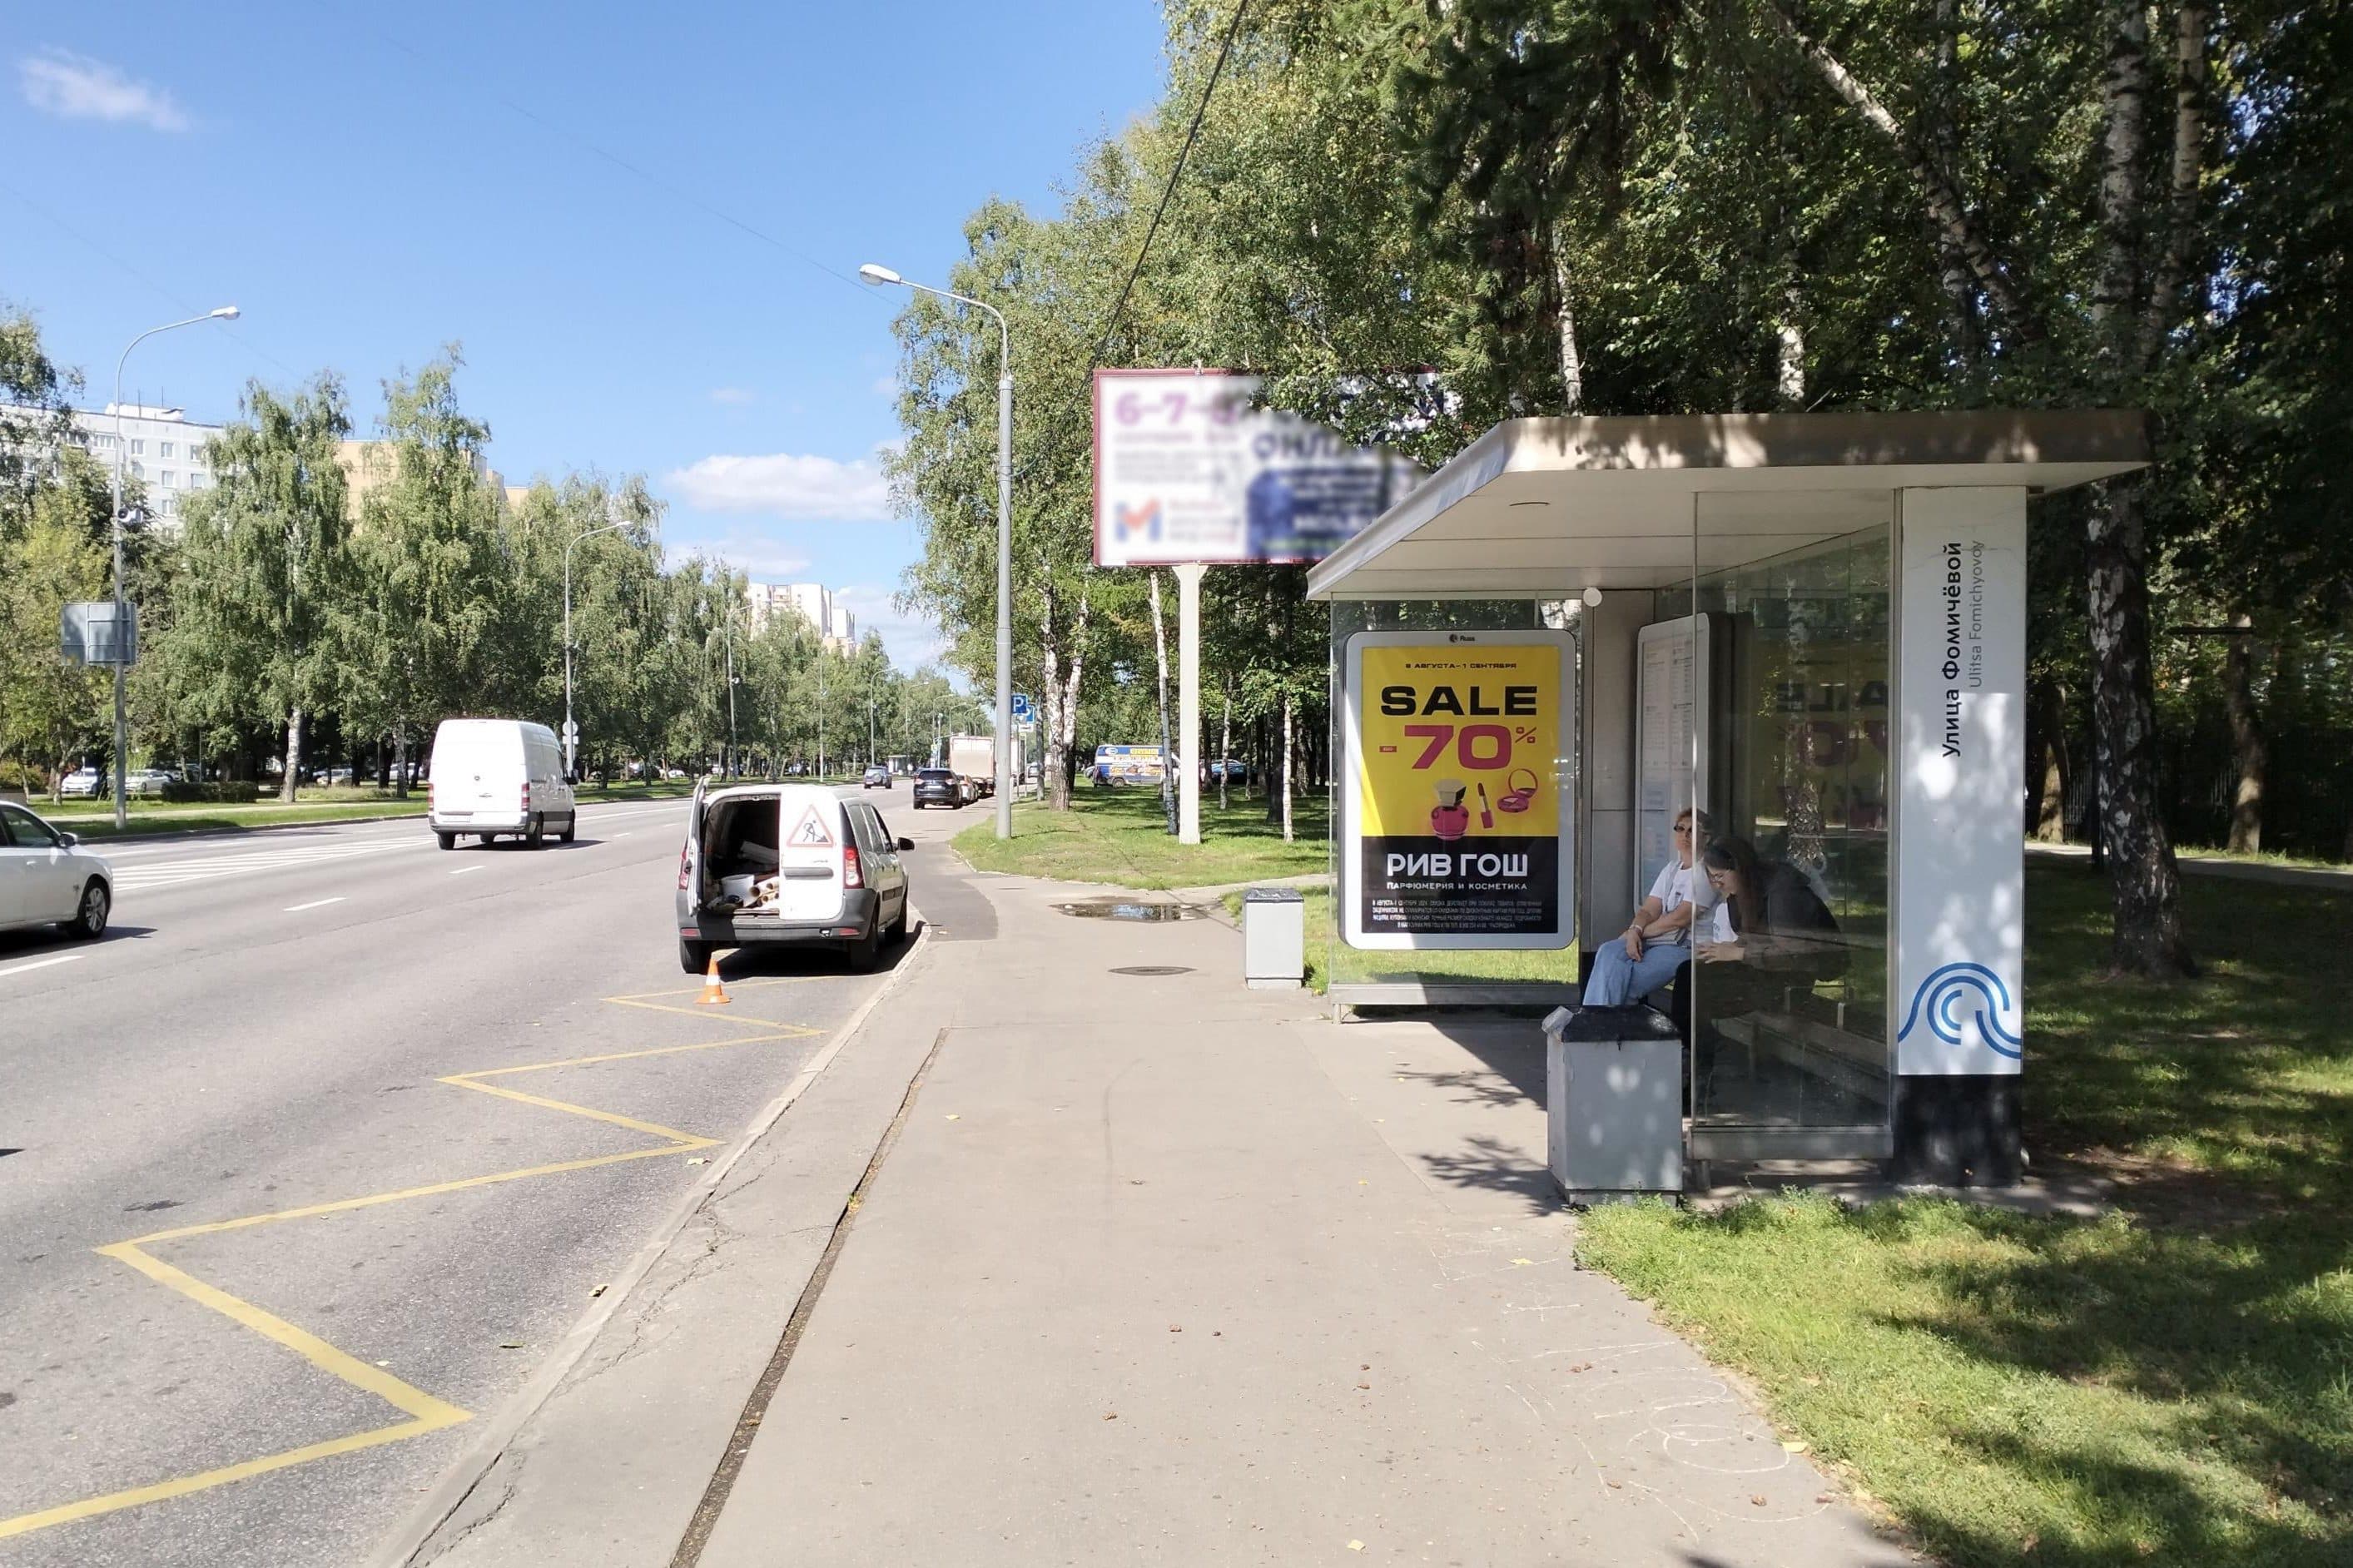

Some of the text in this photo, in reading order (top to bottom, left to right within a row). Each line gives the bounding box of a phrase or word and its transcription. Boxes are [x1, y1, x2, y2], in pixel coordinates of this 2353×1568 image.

[1968, 540, 1984, 687] Ulitsa Fomichyovoy
[1942, 542, 1962, 758] Улица Фомичёвой
[1013, 697, 1024, 713] P
[1380, 685, 1538, 717] SALE
[1386, 852, 1528, 876] РИВ ГОШ
[1386, 881, 1454, 891] ПАРФЮМЕРИЯ
[1468, 882, 1528, 891] КОСМЕТИКА
